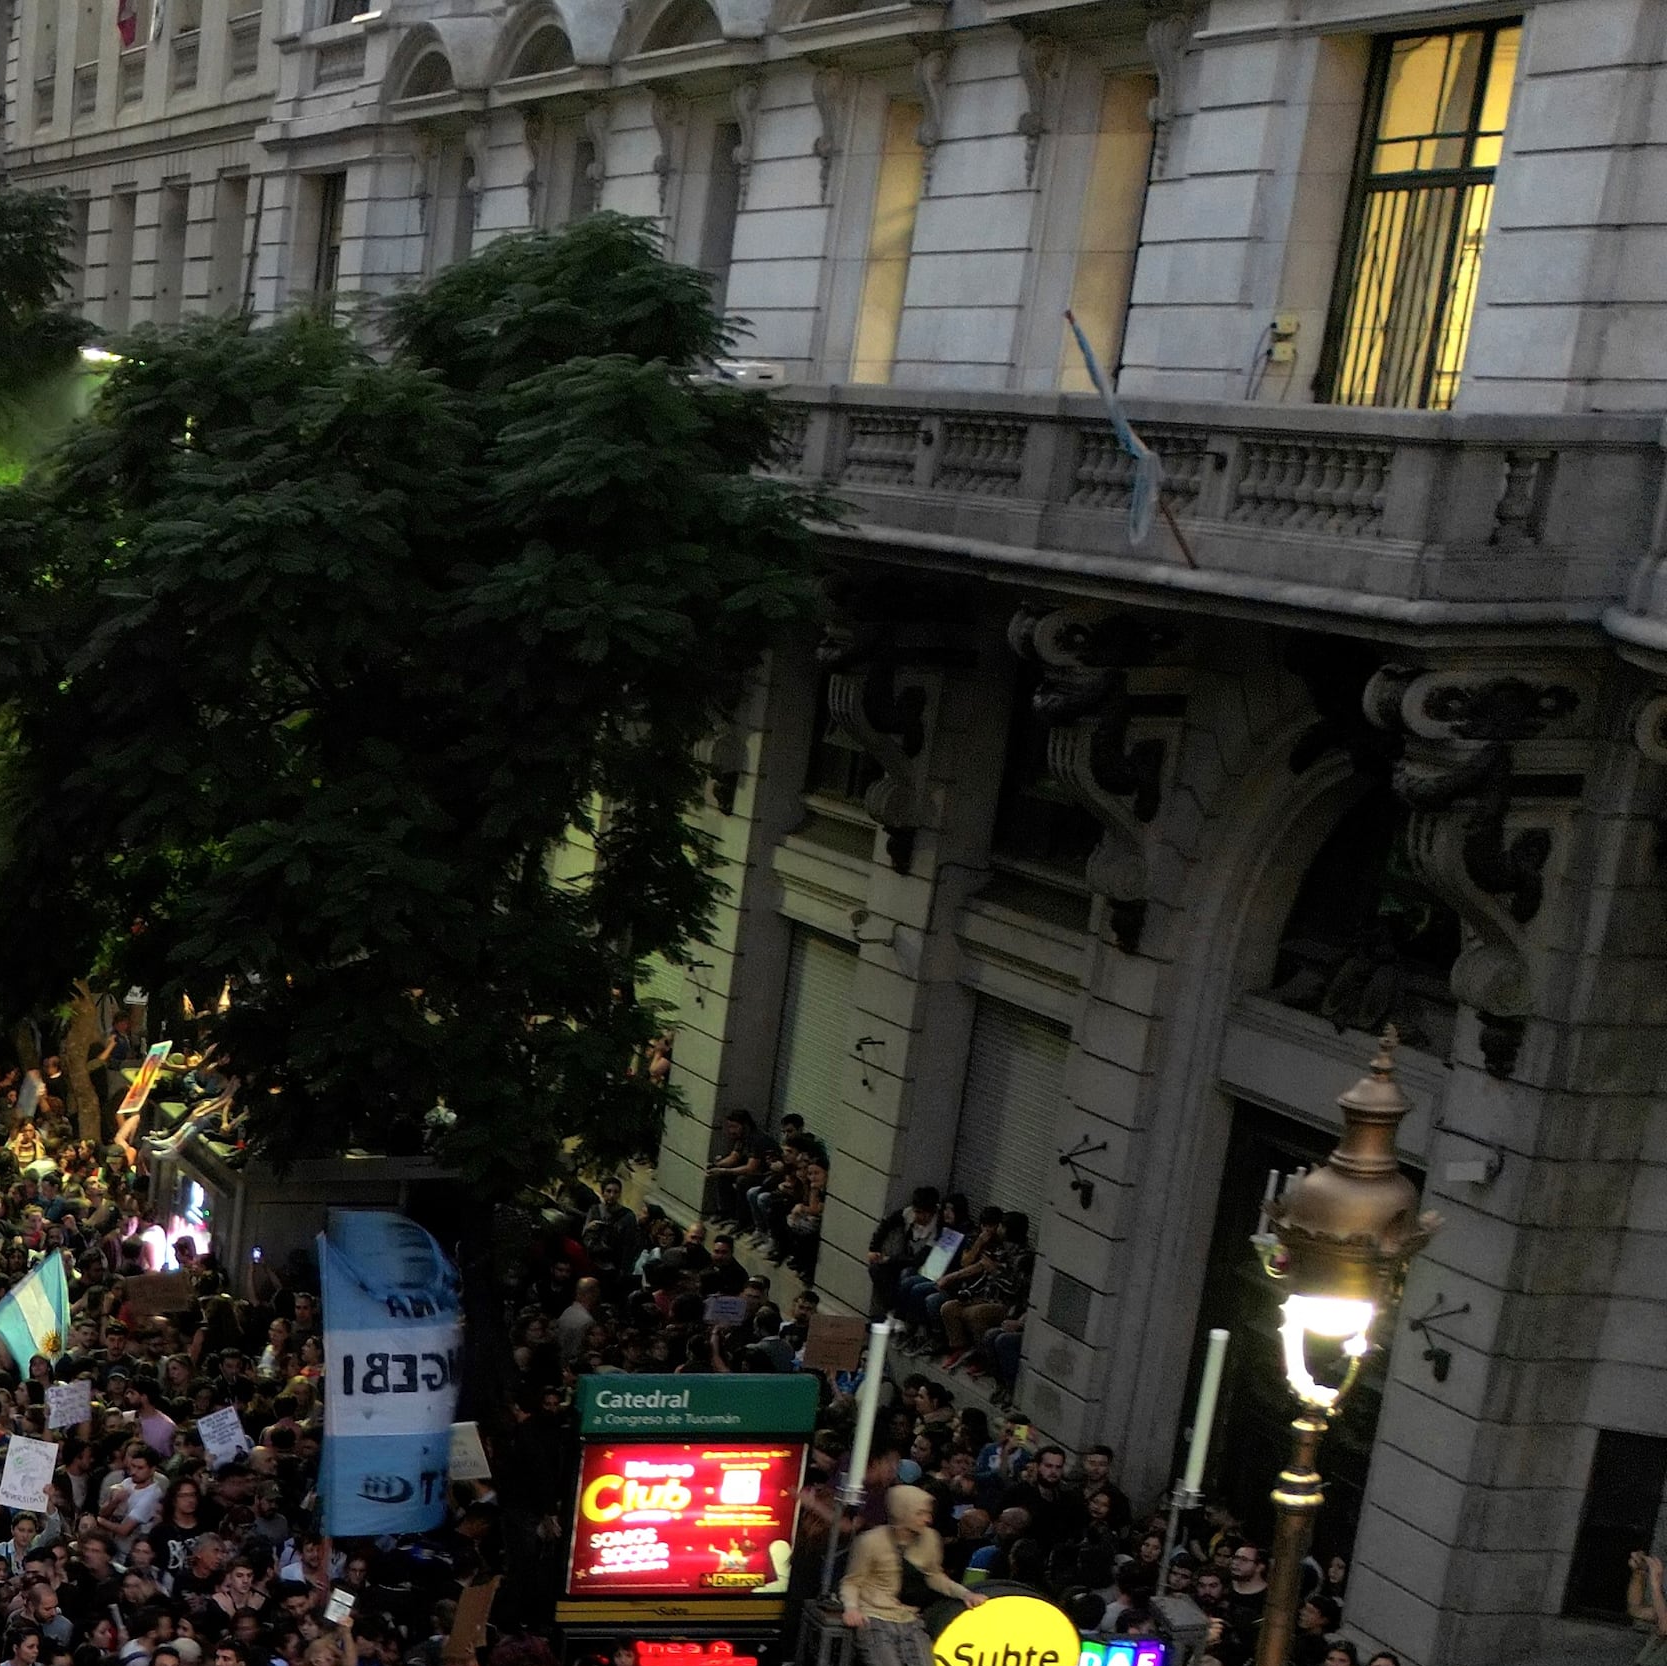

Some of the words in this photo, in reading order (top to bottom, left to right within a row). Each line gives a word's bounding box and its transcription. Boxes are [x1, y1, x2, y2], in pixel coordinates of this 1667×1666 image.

[594, 1389, 691, 1409] Catedral
[593, 1415, 602, 1425] a
[605, 1412, 663, 1427] Congreso
[665, 1412, 682, 1425] de
[684, 1412, 742, 1425] Tucumán
[581, 1474, 692, 1523] Club
[589, 1527, 657, 1549] SOMOS
[600, 1542, 669, 1565] SOCIOS
